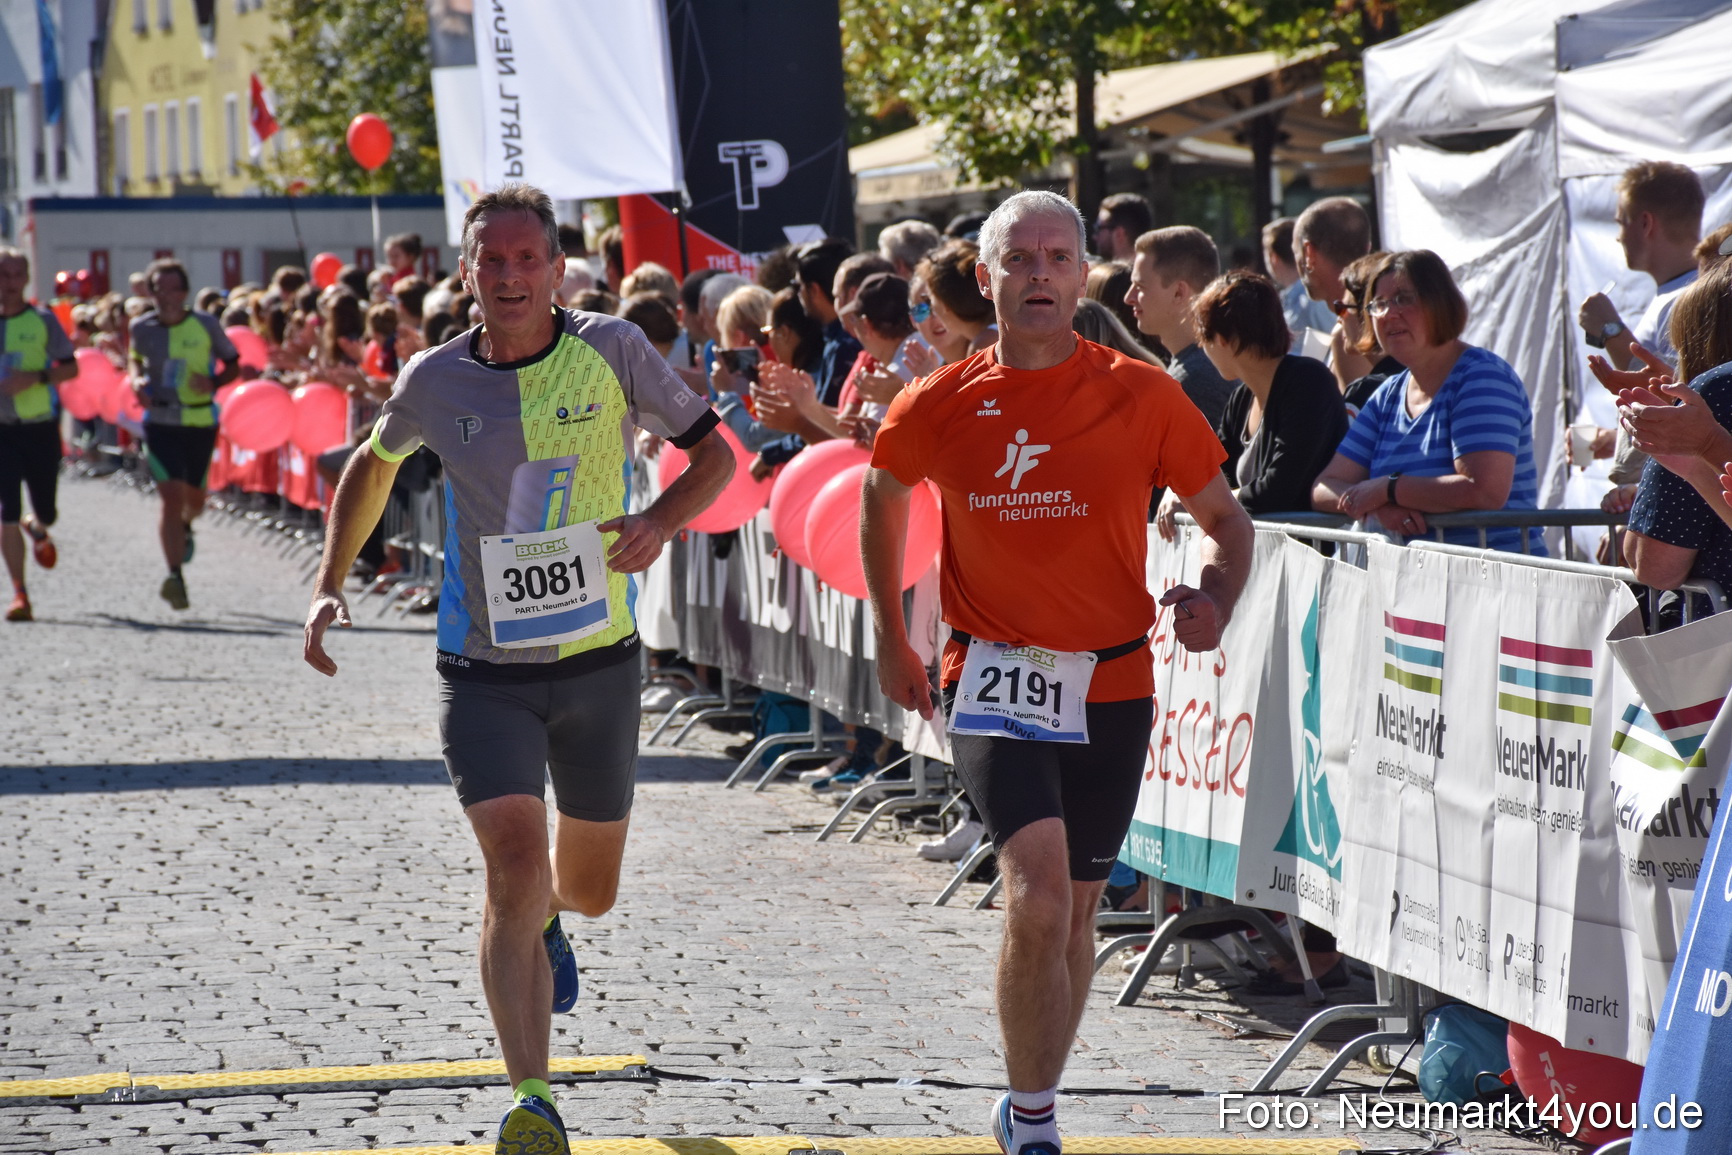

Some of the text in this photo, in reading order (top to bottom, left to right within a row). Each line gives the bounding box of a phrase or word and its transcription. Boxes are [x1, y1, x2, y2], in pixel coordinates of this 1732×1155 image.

[976, 408, 1002, 417] erima
[968, 490, 1072, 511] funrunners
[999, 502, 1089, 522] neumarkt
[515, 537, 569, 557] BOCK
[503, 554, 586, 603] 3081
[515, 598, 578, 615] PARTL Neumarkt
[976, 666, 1063, 716] 2191
[983, 706, 1050, 724] PARTL Neumarkt
[1003, 719, 1037, 740] Uwe
[1269, 866, 1296, 895] Jura
[1662, 857, 1703, 883] genie
